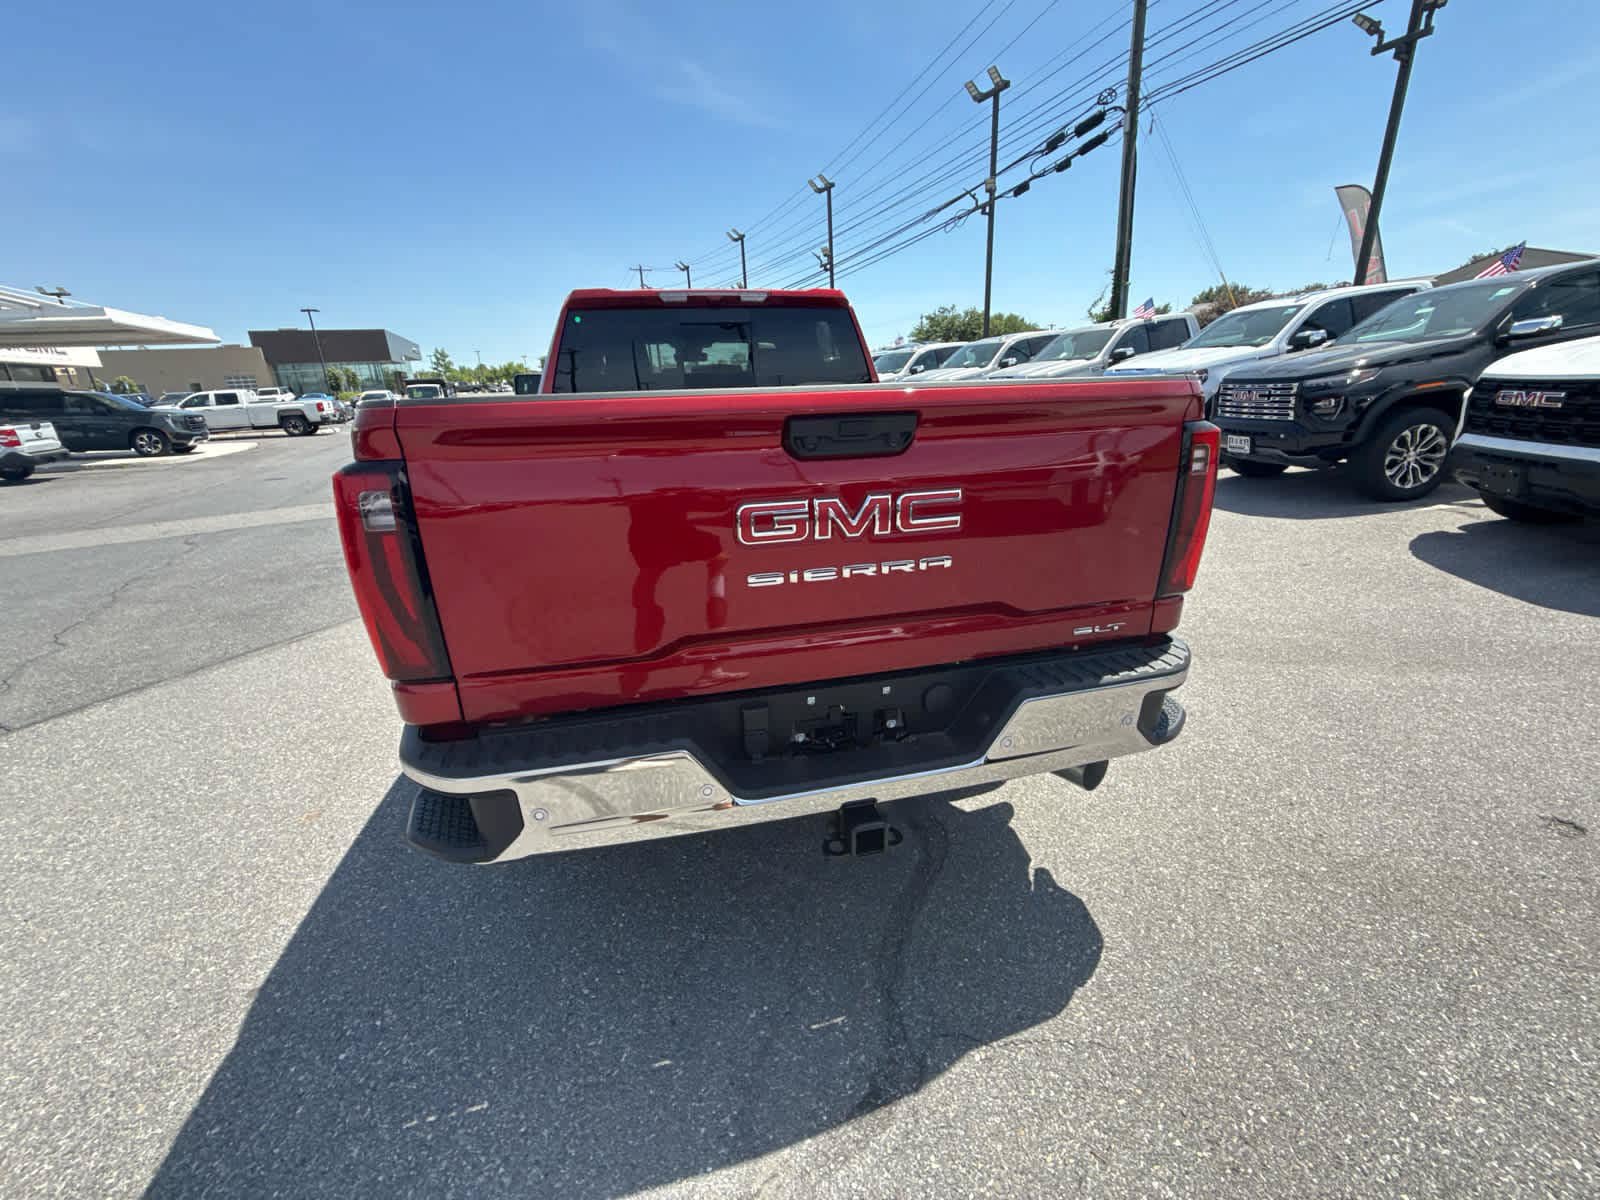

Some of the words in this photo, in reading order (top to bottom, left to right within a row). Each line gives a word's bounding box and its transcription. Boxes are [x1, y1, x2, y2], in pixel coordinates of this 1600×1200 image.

[1495, 389, 1566, 408] GMC
[736, 488, 962, 545] GMC
[747, 555, 952, 588] SIERRA
[1073, 622, 1127, 636] SLT
